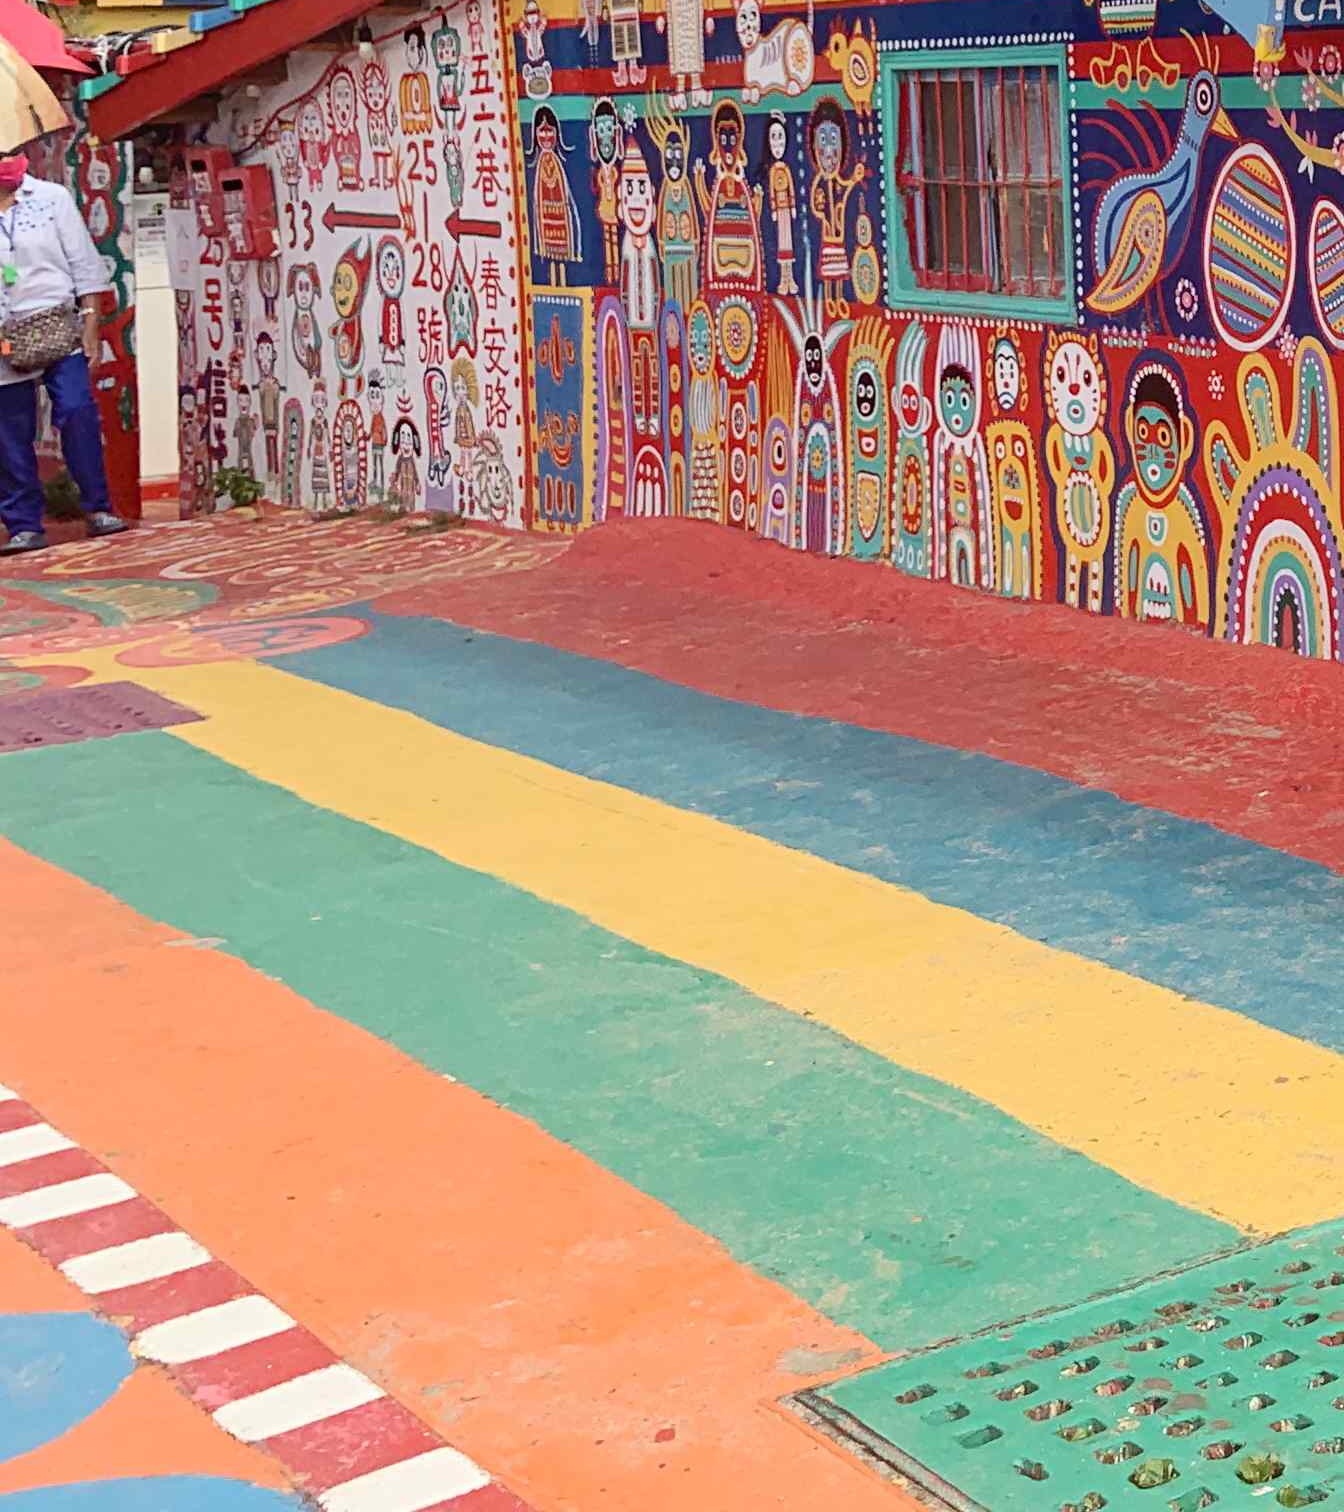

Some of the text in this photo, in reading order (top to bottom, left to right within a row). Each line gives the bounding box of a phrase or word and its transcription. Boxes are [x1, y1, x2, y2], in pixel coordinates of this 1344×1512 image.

[407, 140, 438, 186] 25
[470, 55, 503, 208] 五六巷
[411, 243, 443, 292] 28
[479, 252, 512, 429] 春安路
